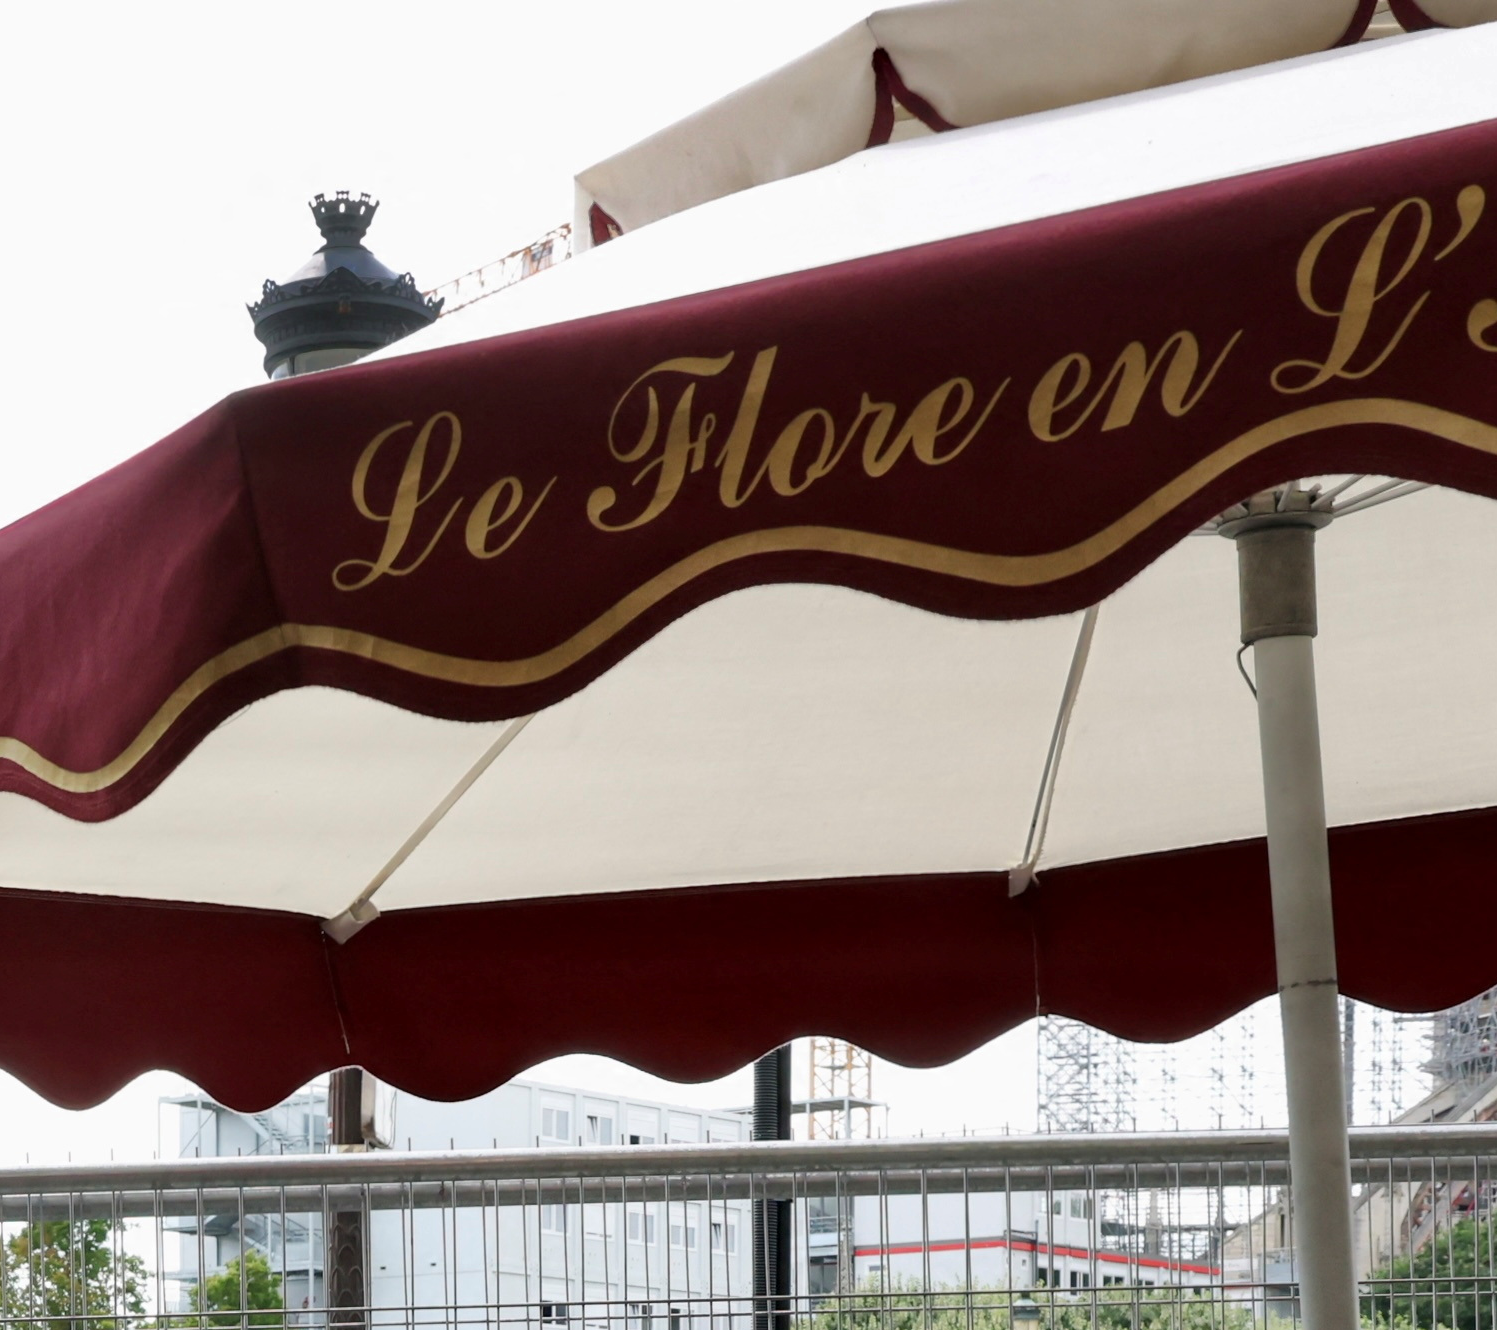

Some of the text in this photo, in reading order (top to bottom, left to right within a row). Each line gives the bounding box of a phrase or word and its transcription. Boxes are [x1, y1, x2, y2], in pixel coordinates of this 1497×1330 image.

[332, 410, 558, 592] Le
[586, 345, 1011, 533] Flore
[1027, 329, 1243, 442] en
